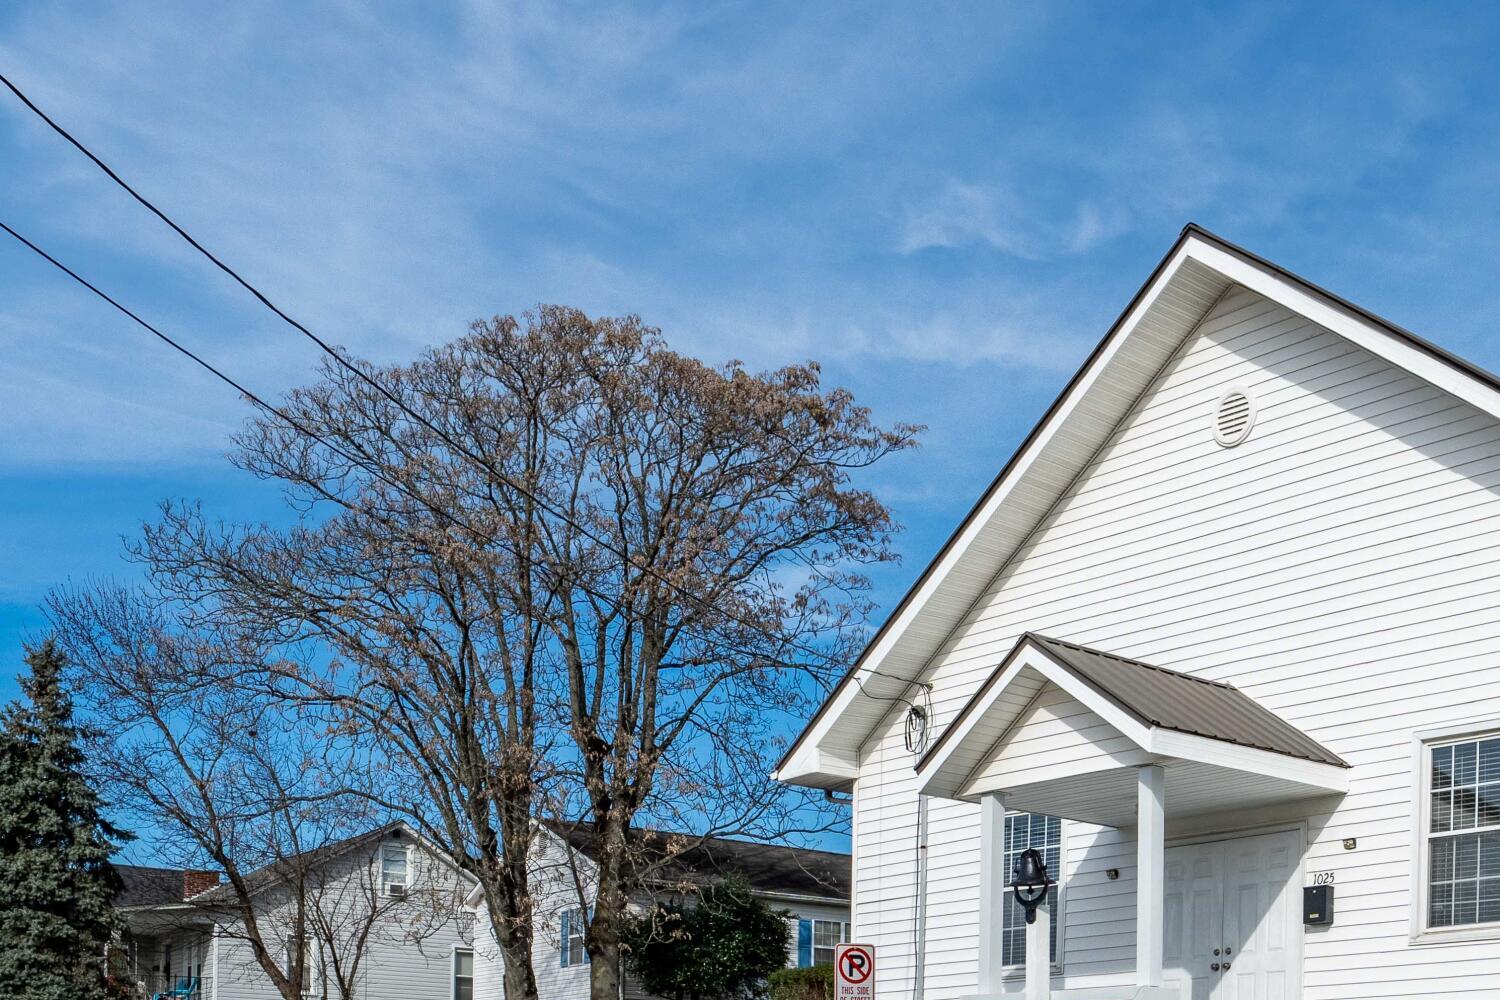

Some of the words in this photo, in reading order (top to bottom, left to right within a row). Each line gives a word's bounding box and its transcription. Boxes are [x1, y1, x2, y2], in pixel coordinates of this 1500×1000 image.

[1313, 872, 1335, 885] 1025
[841, 986, 854, 995] THIS
[856, 986, 870, 995] SIDE
